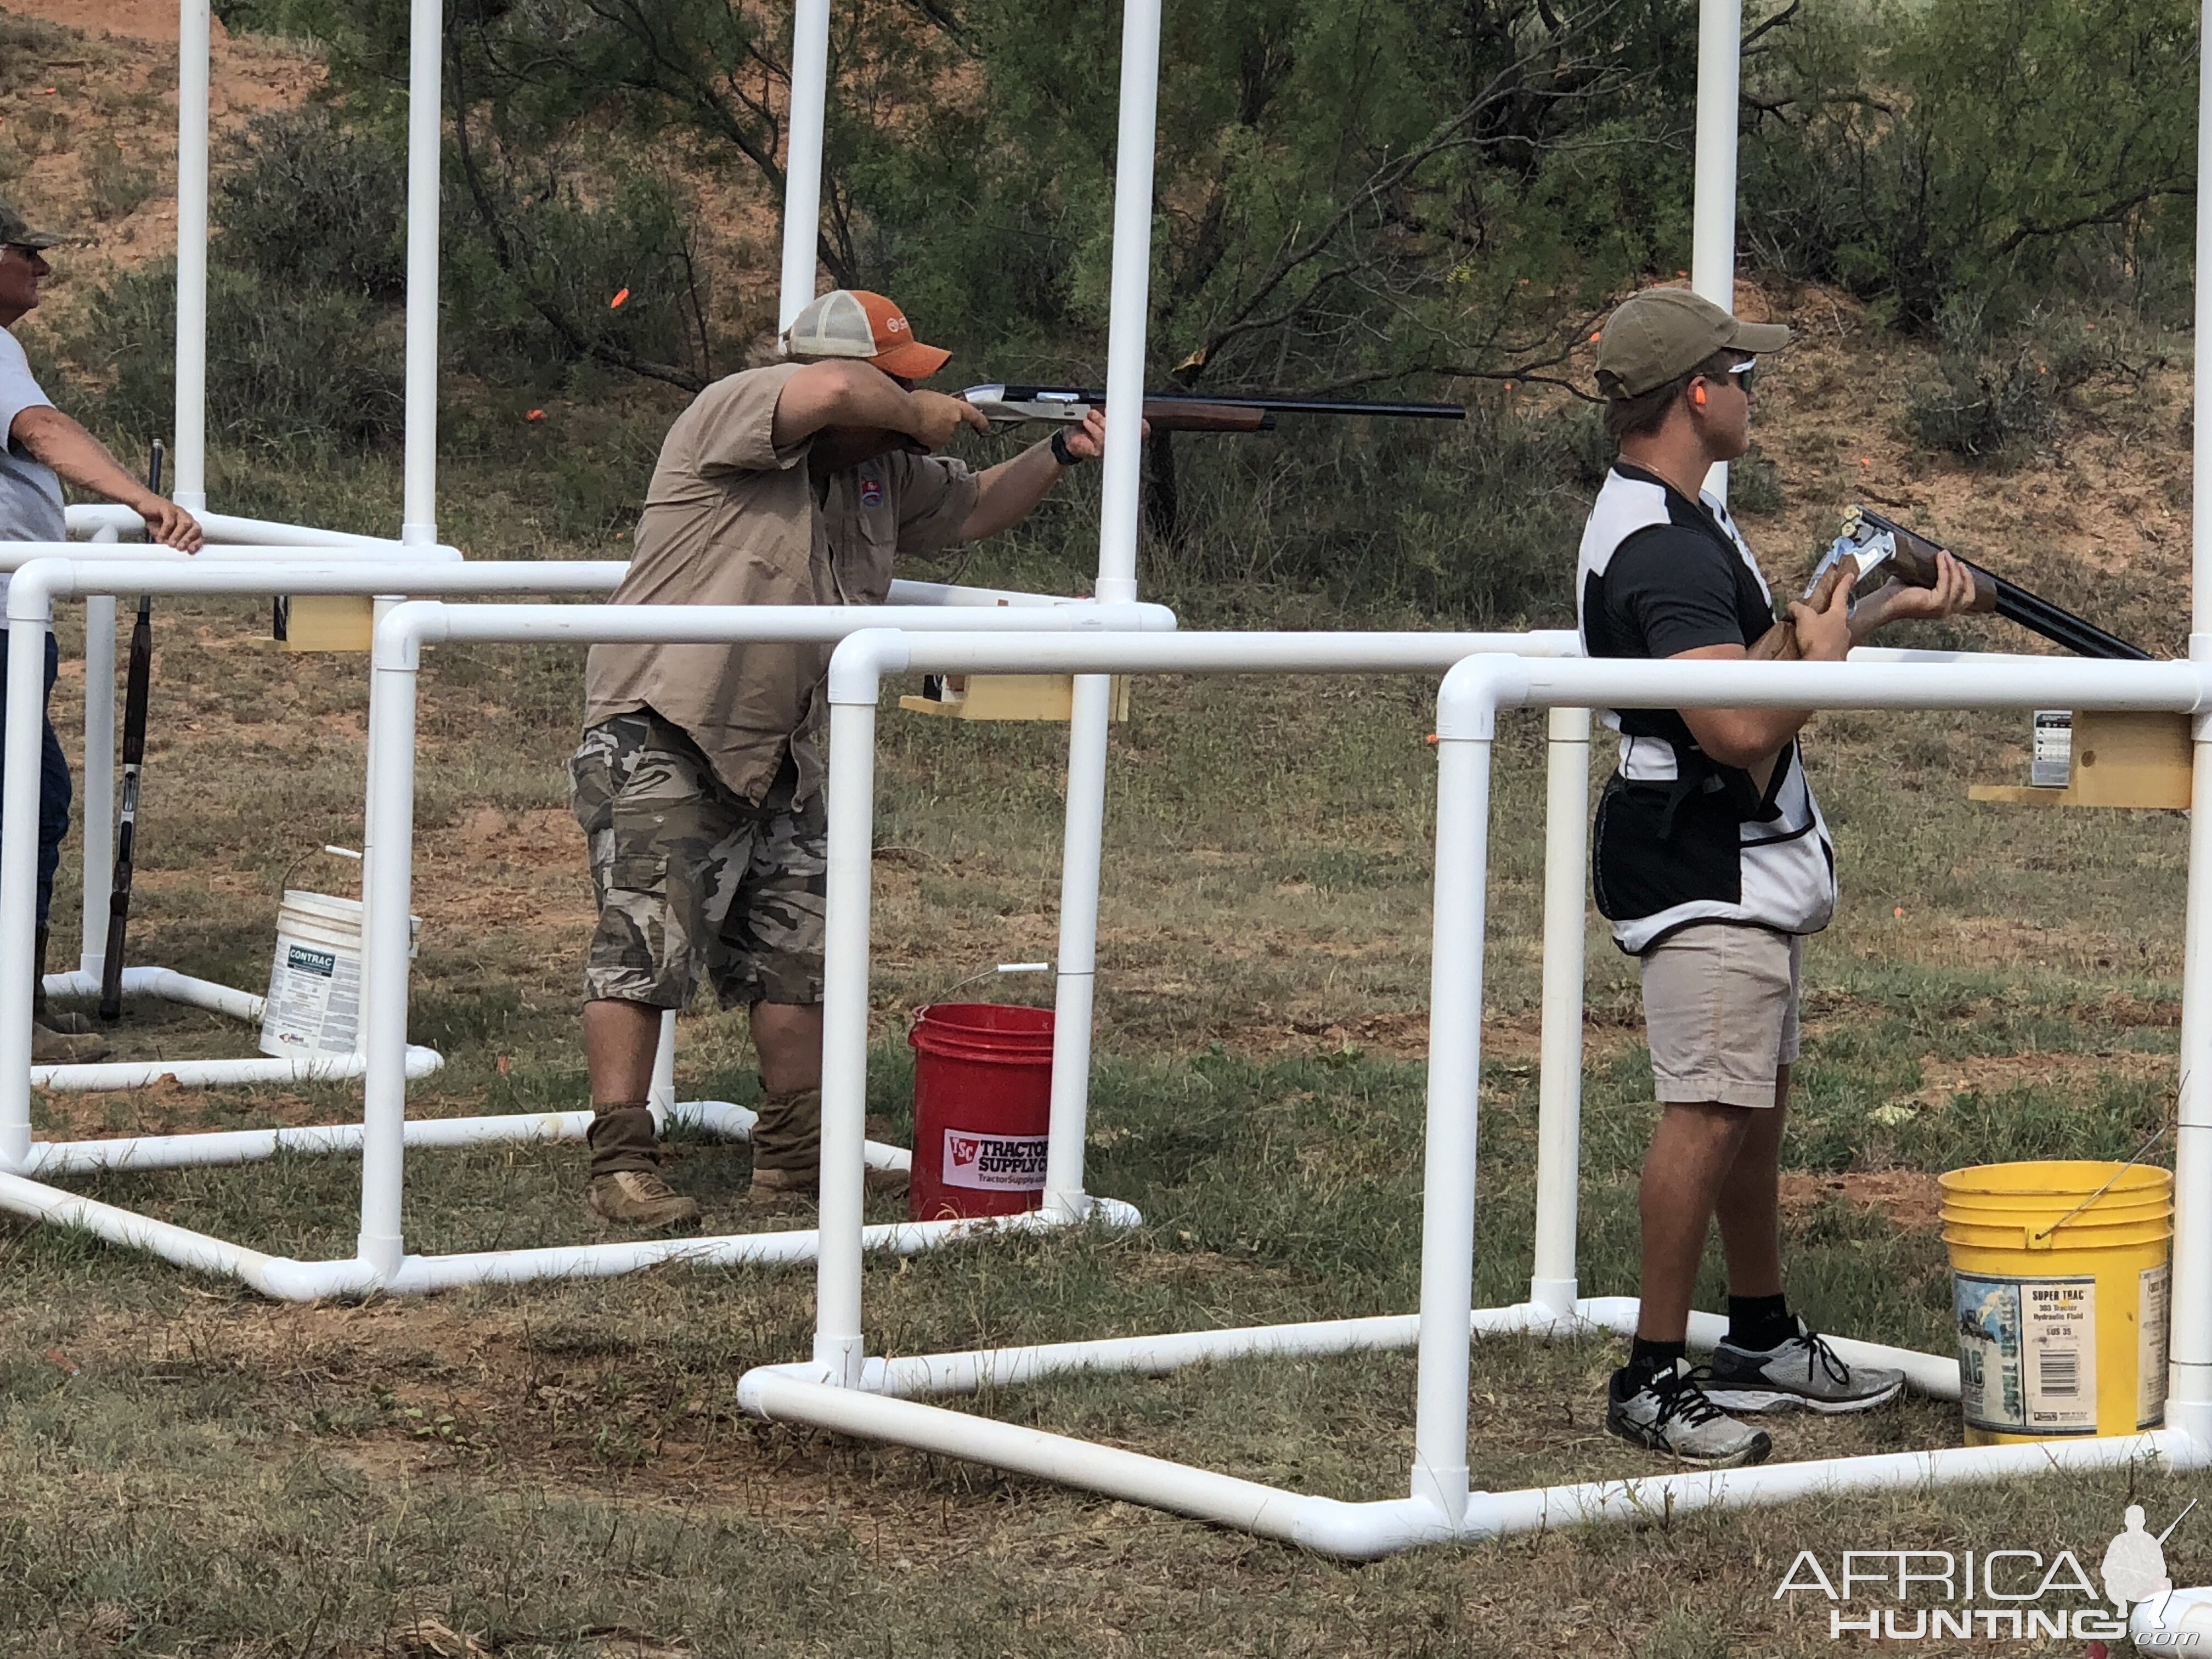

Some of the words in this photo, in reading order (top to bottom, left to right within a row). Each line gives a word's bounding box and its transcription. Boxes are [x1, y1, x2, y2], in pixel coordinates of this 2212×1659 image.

[290, 949, 332, 967] CONTRAC
[952, 1137, 973, 1162] TSC
[978, 1156, 1037, 1173] SUPPLY
[2032, 1290, 2059, 1301] SUPER
[2062, 1290, 2084, 1300] TRAC
[2033, 1313, 2064, 1322] Hydraulic
